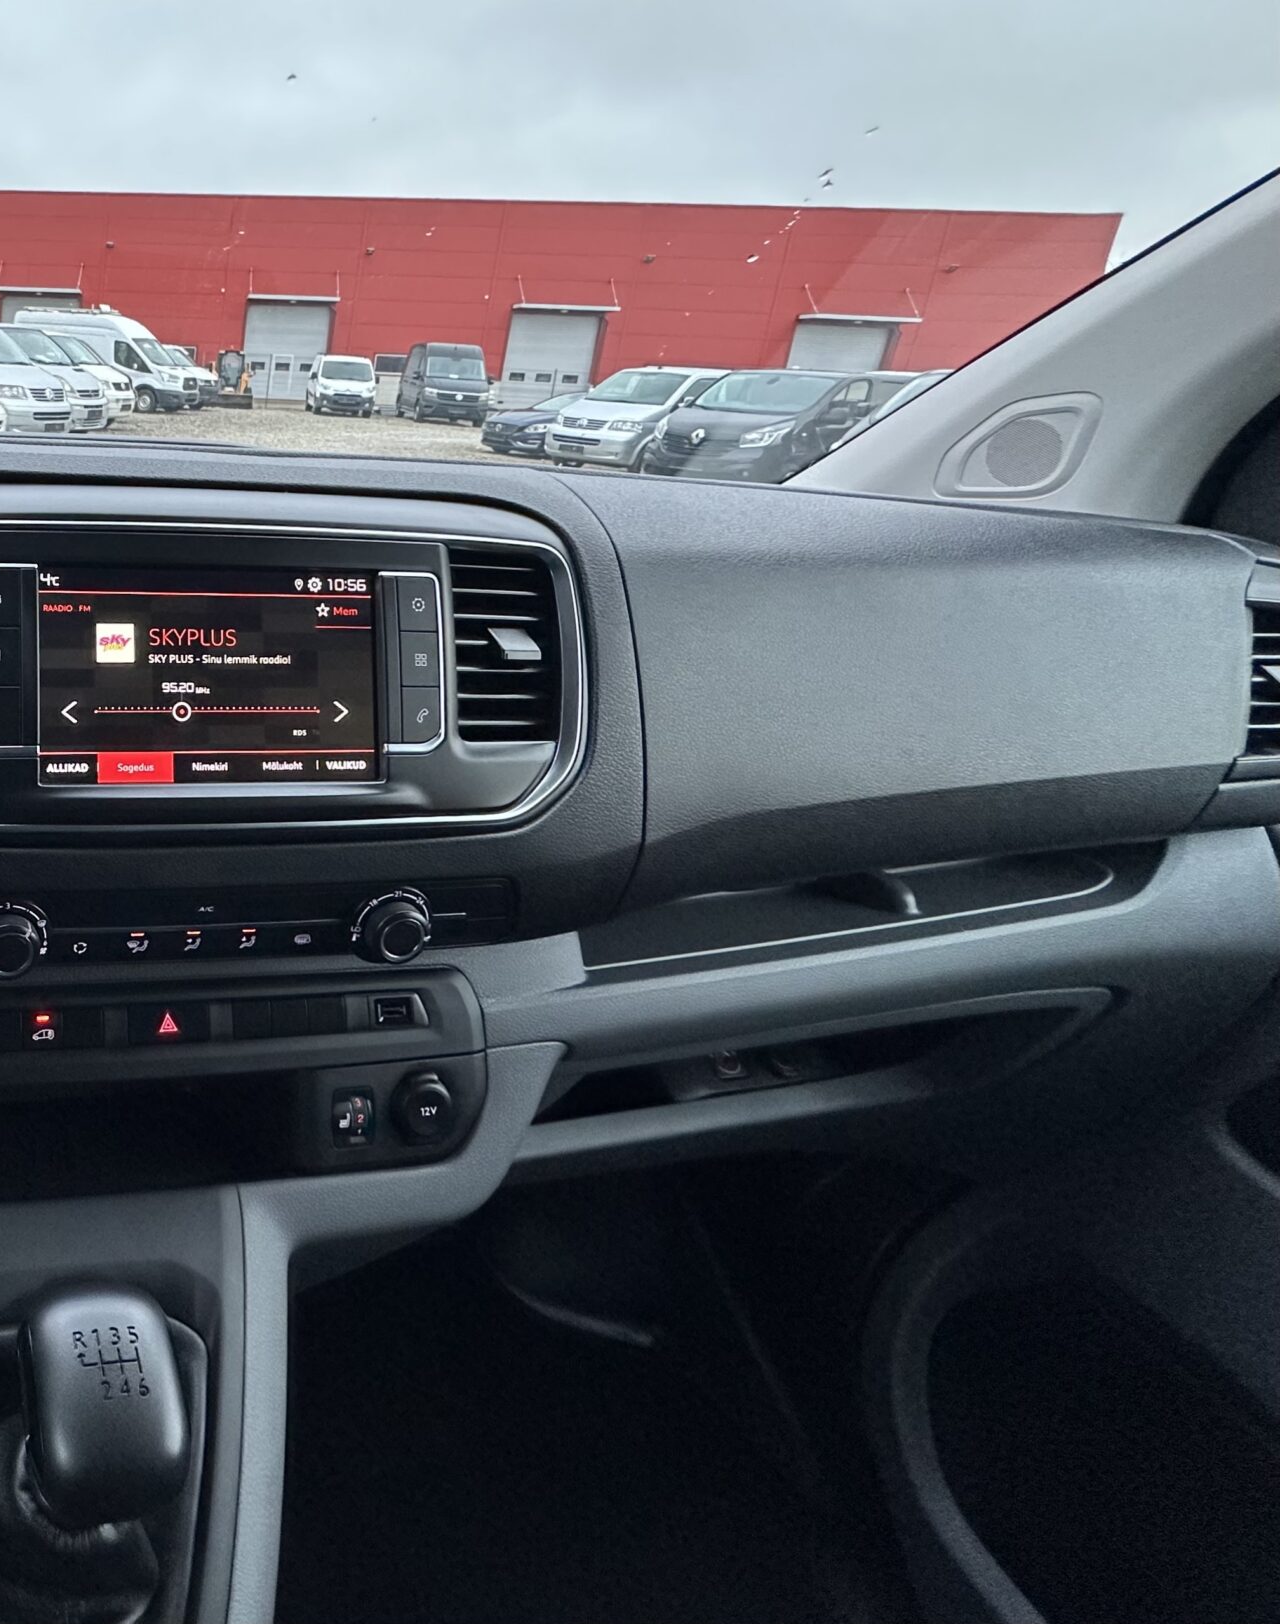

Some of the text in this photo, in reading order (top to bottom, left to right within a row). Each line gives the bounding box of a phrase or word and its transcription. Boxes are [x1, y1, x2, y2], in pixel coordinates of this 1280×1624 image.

[327, 578, 367, 592] 10:56
[42, 604, 73, 613] RAADIO
[333, 606, 358, 616] Mem
[148, 628, 237, 647] SKYPLUS
[148, 653, 167, 664] SKY
[169, 654, 194, 664] PLUS
[202, 654, 222, 664] Sinu
[224, 654, 258, 665] lemmik
[46, 763, 89, 773] ALLIKAD
[191, 762, 228, 771] Nimekiri
[325, 760, 367, 770] VALIKUD
[420, 1106, 437, 1117] 12V
[357, 1114, 365, 1123] 2
[73, 1326, 139, 1349] R 1 3 5
[101, 1378, 150, 1400] 2 4 6
